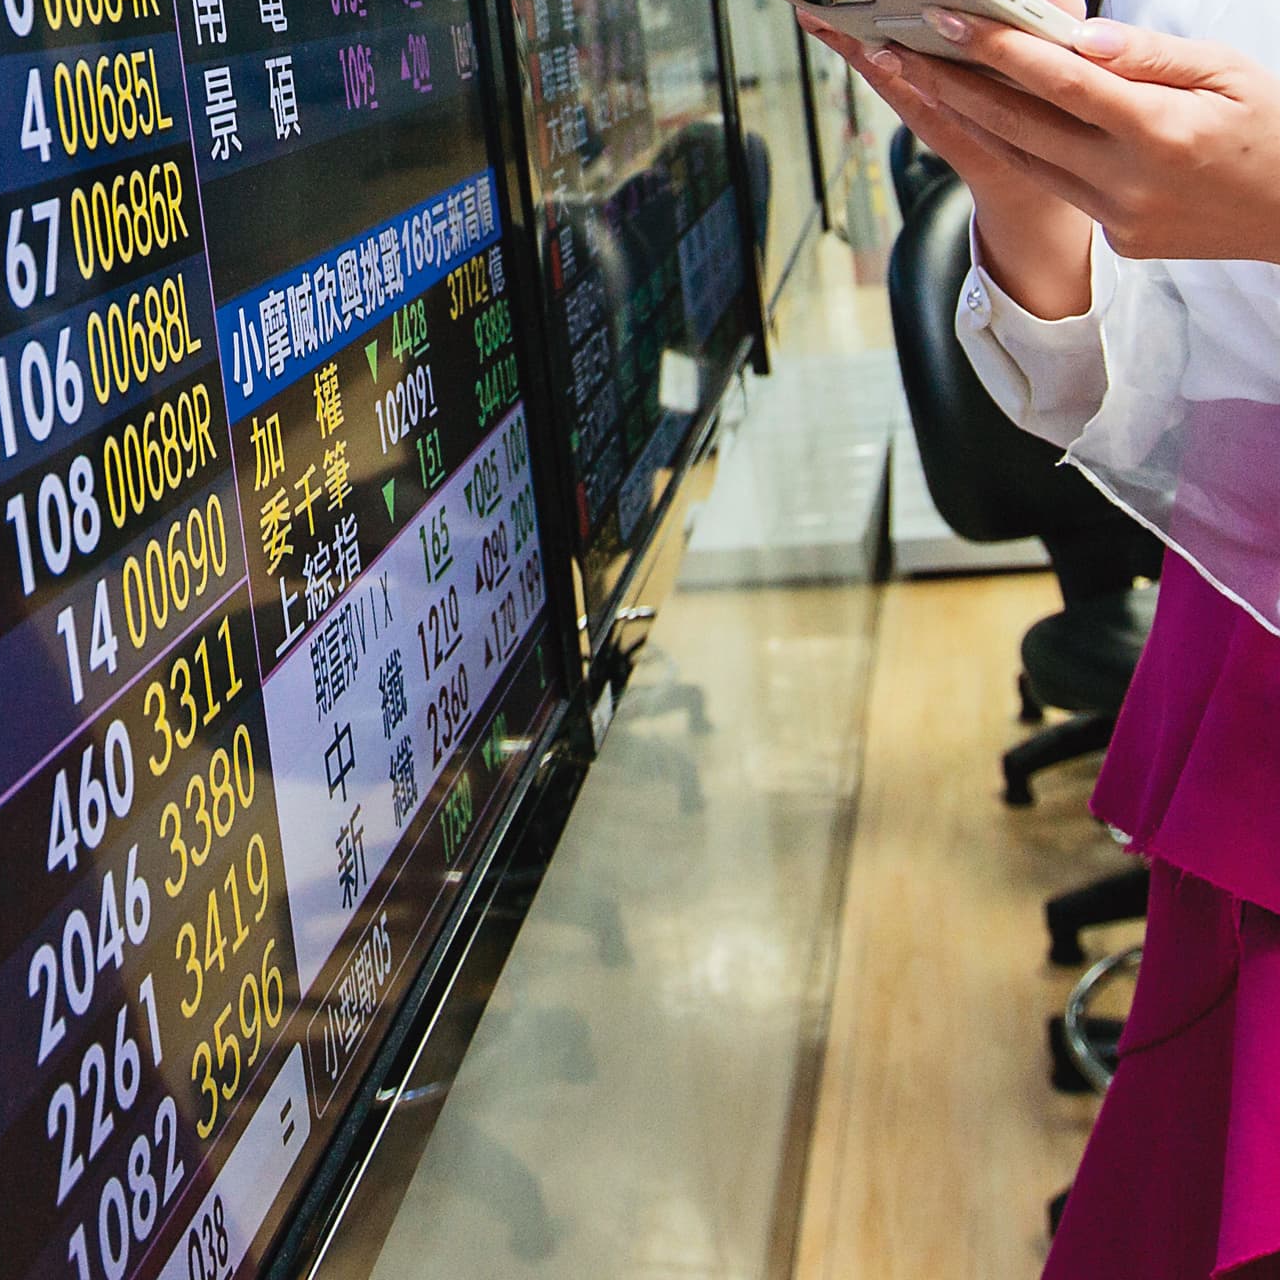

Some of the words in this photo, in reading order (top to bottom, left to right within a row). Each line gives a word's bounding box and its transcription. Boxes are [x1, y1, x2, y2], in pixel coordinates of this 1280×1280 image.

[21, 68, 52, 163] 4
[54, 48, 173, 156] 00685L
[204, 55, 306, 161] 景碩
[339, 43, 376, 111] 1095
[5, 198, 61, 310] 67
[70, 161, 189, 280] 00686R
[87, 273, 202, 405] 00688L
[6, 455, 101, 597] 108
[103, 383, 218, 528] 00689R
[251, 362, 347, 492] 加權
[392, 298, 428, 363] 4428
[260, 440, 354, 576] 委千筆
[375, 364, 436, 454] 102091
[57, 578, 118, 705] 14
[123, 493, 227, 650] 00690
[275, 513, 362, 659] 上綜指
[416, 427, 444, 490] 151
[419, 506, 450, 584] 165
[474, 448, 500, 519] 005
[47, 719, 134, 874] 460
[144, 615, 244, 777] 3311
[324, 649, 408, 803] 中纖
[418, 585, 460, 681] 1210
[483, 521, 508, 592] 090
[336, 735, 418, 910] 新纖
[427, 663, 469, 771] 2360
[28, 843, 151, 1066] 2046
[159, 724, 255, 898] 3380
[324, 914, 393, 1081] 小型期05
[47, 973, 162, 1207] 2261
[175, 833, 269, 1018] 3419
[68, 1095, 185, 1280] 1082
[191, 938, 284, 1140] 3596
